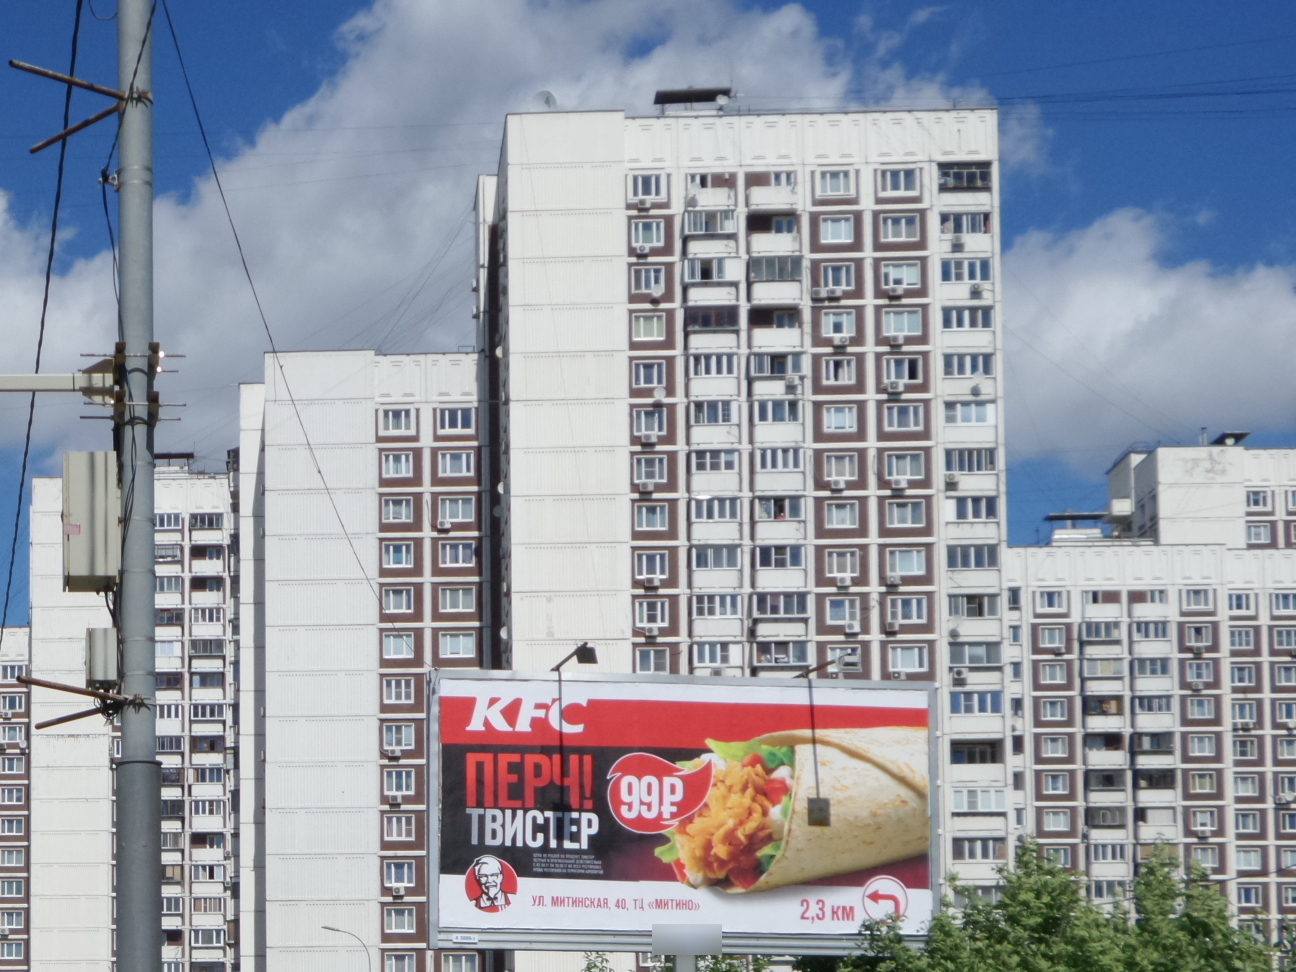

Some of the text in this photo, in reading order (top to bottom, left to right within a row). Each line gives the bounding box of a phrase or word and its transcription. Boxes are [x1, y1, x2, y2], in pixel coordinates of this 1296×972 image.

[465, 696, 588, 734] KFC
[466, 752, 595, 810] ПЕРЧ!
[465, 807, 600, 850] ТВИСТЕР
[531, 895, 701, 911] УЛ. МИТИНСКАЯ, 40, ТЦ «МИТИНО»
[800, 898, 826, 924] 2,3
